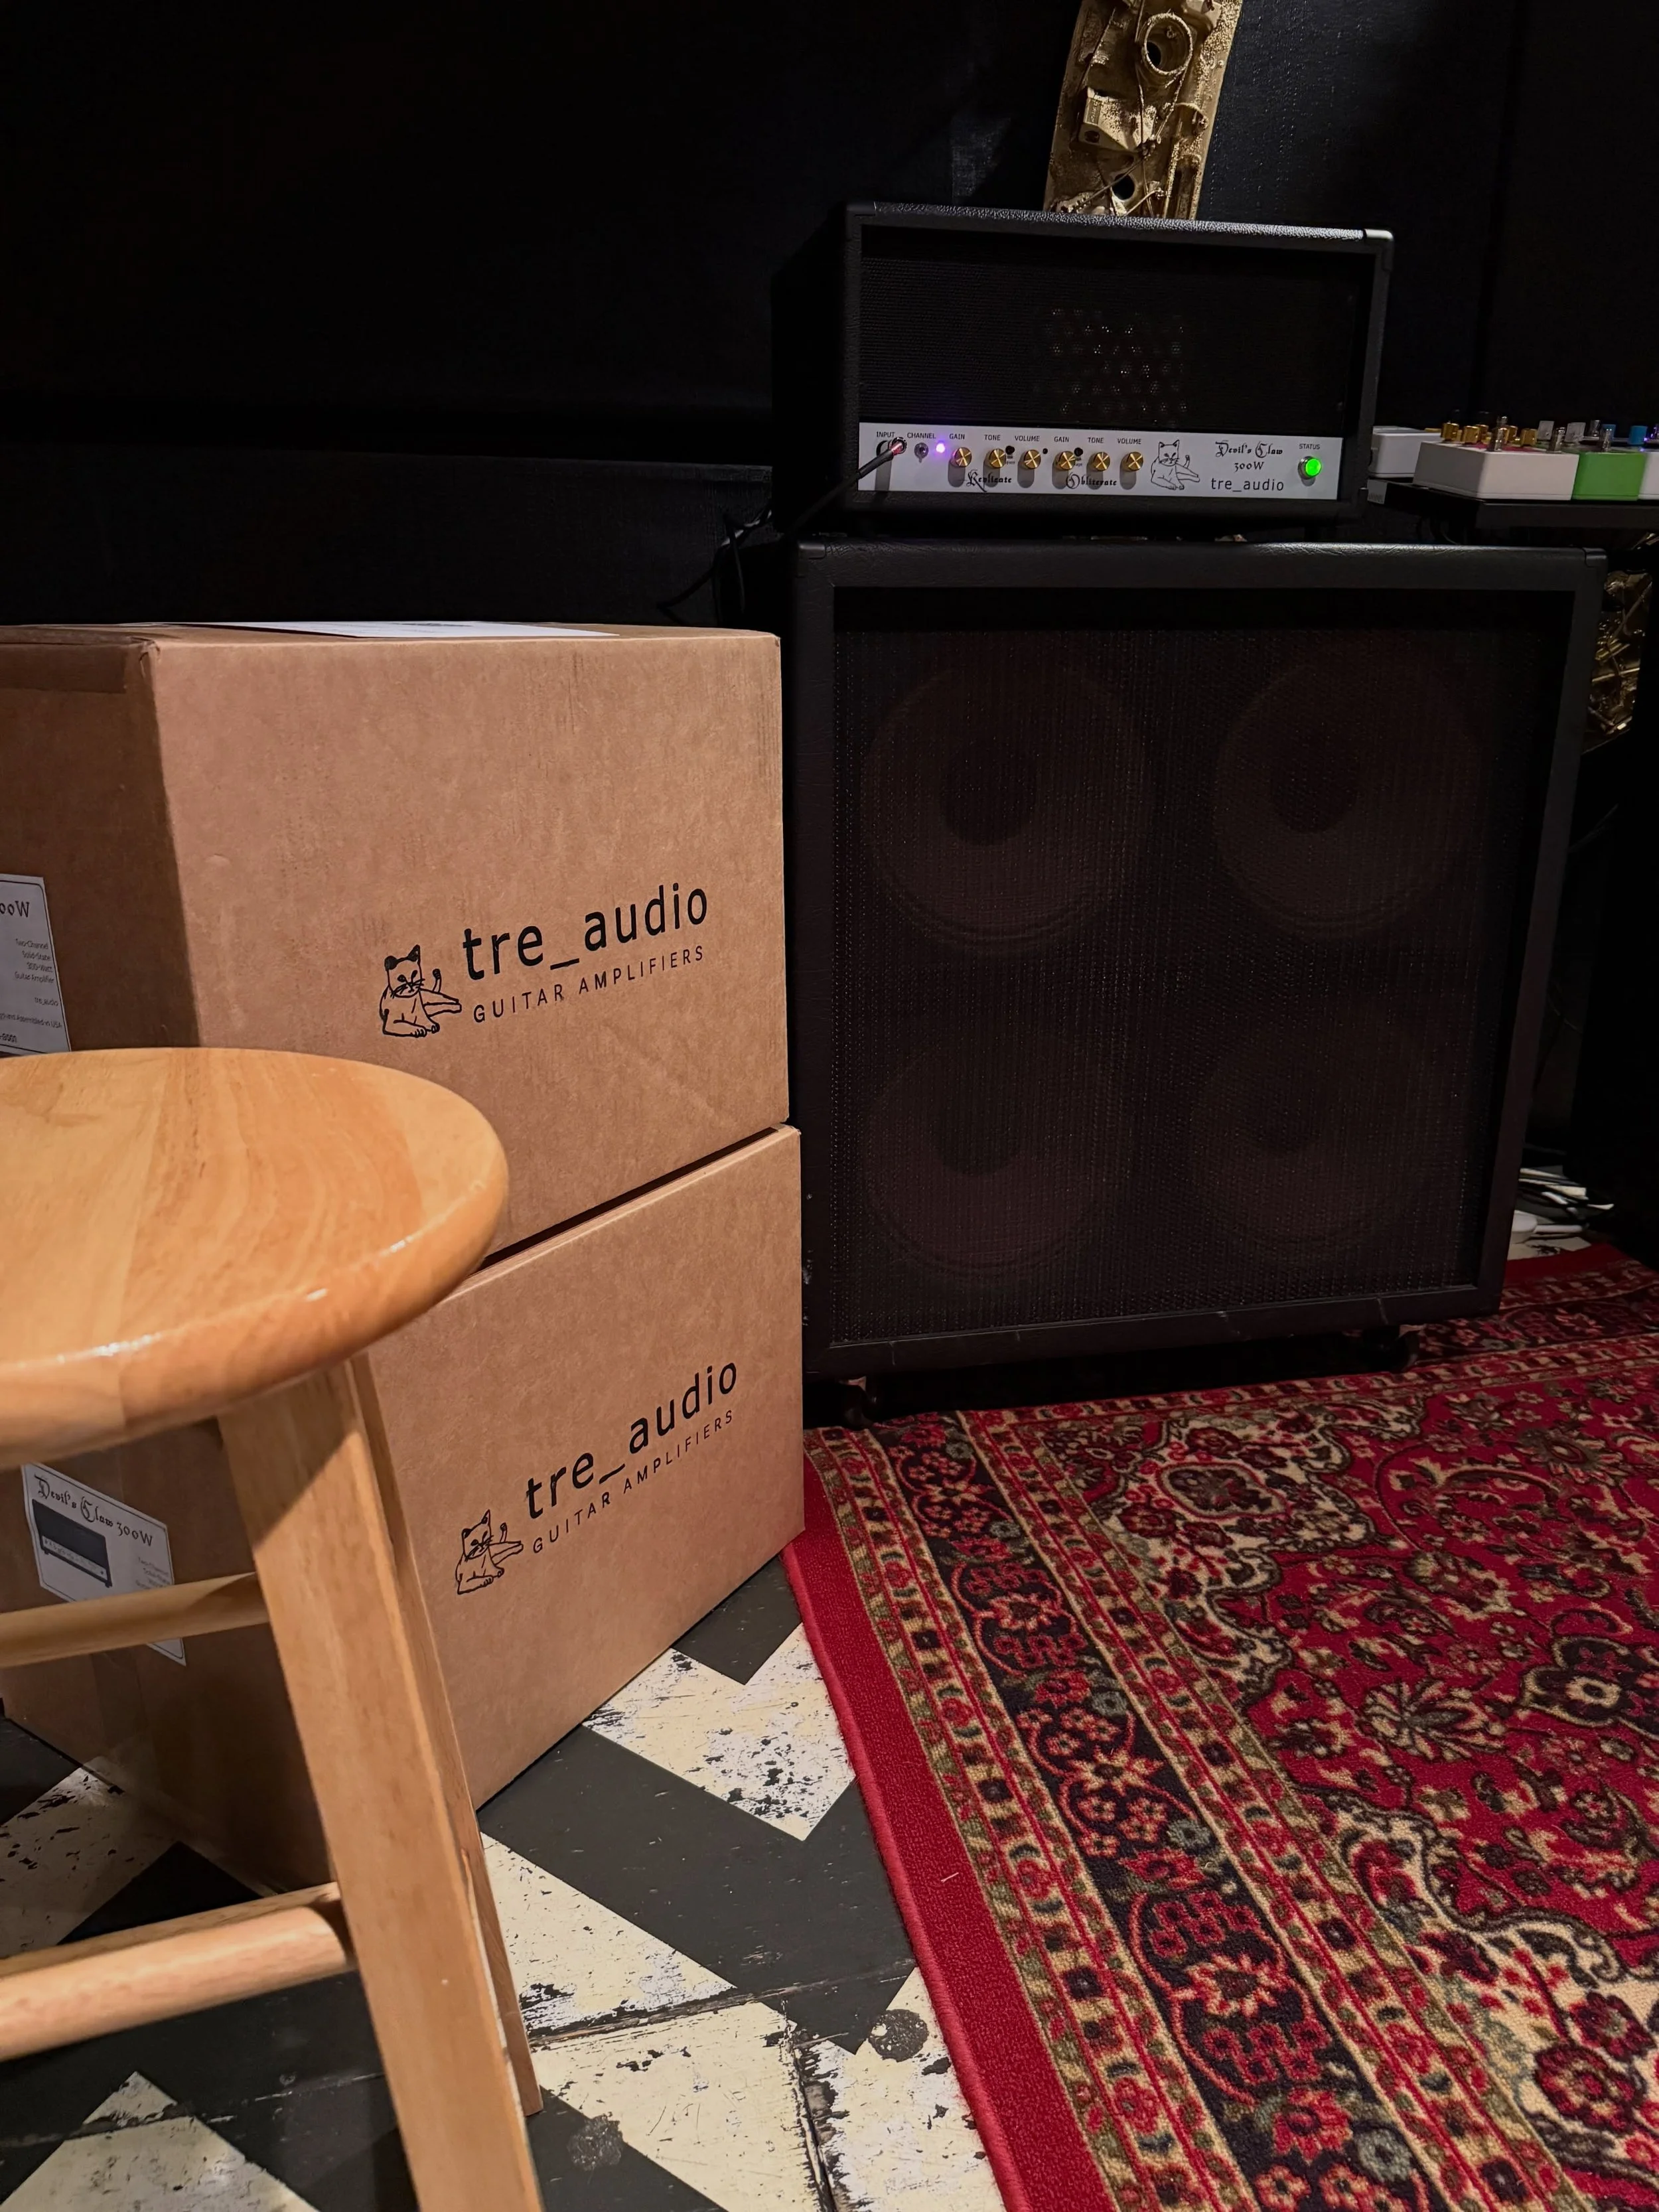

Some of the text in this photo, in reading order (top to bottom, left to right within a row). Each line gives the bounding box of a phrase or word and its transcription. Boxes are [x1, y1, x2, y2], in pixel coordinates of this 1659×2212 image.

[1215, 440, 1283, 458] Devil's Claw
[1234, 461, 1264, 473] 300W
[966, 469, 1012, 492] Replicate
[1211, 477, 1284, 492] tre_audio
[463, 883, 707, 981] tre_audio
[472, 946, 704, 1023] GUITAR AMPLIFIERS
[526, 1363, 737, 1519] tre_audio
[533, 1410, 733, 1554] GUITAR AMPLIFIERS
[116, 1522, 153, 1547] 300W
